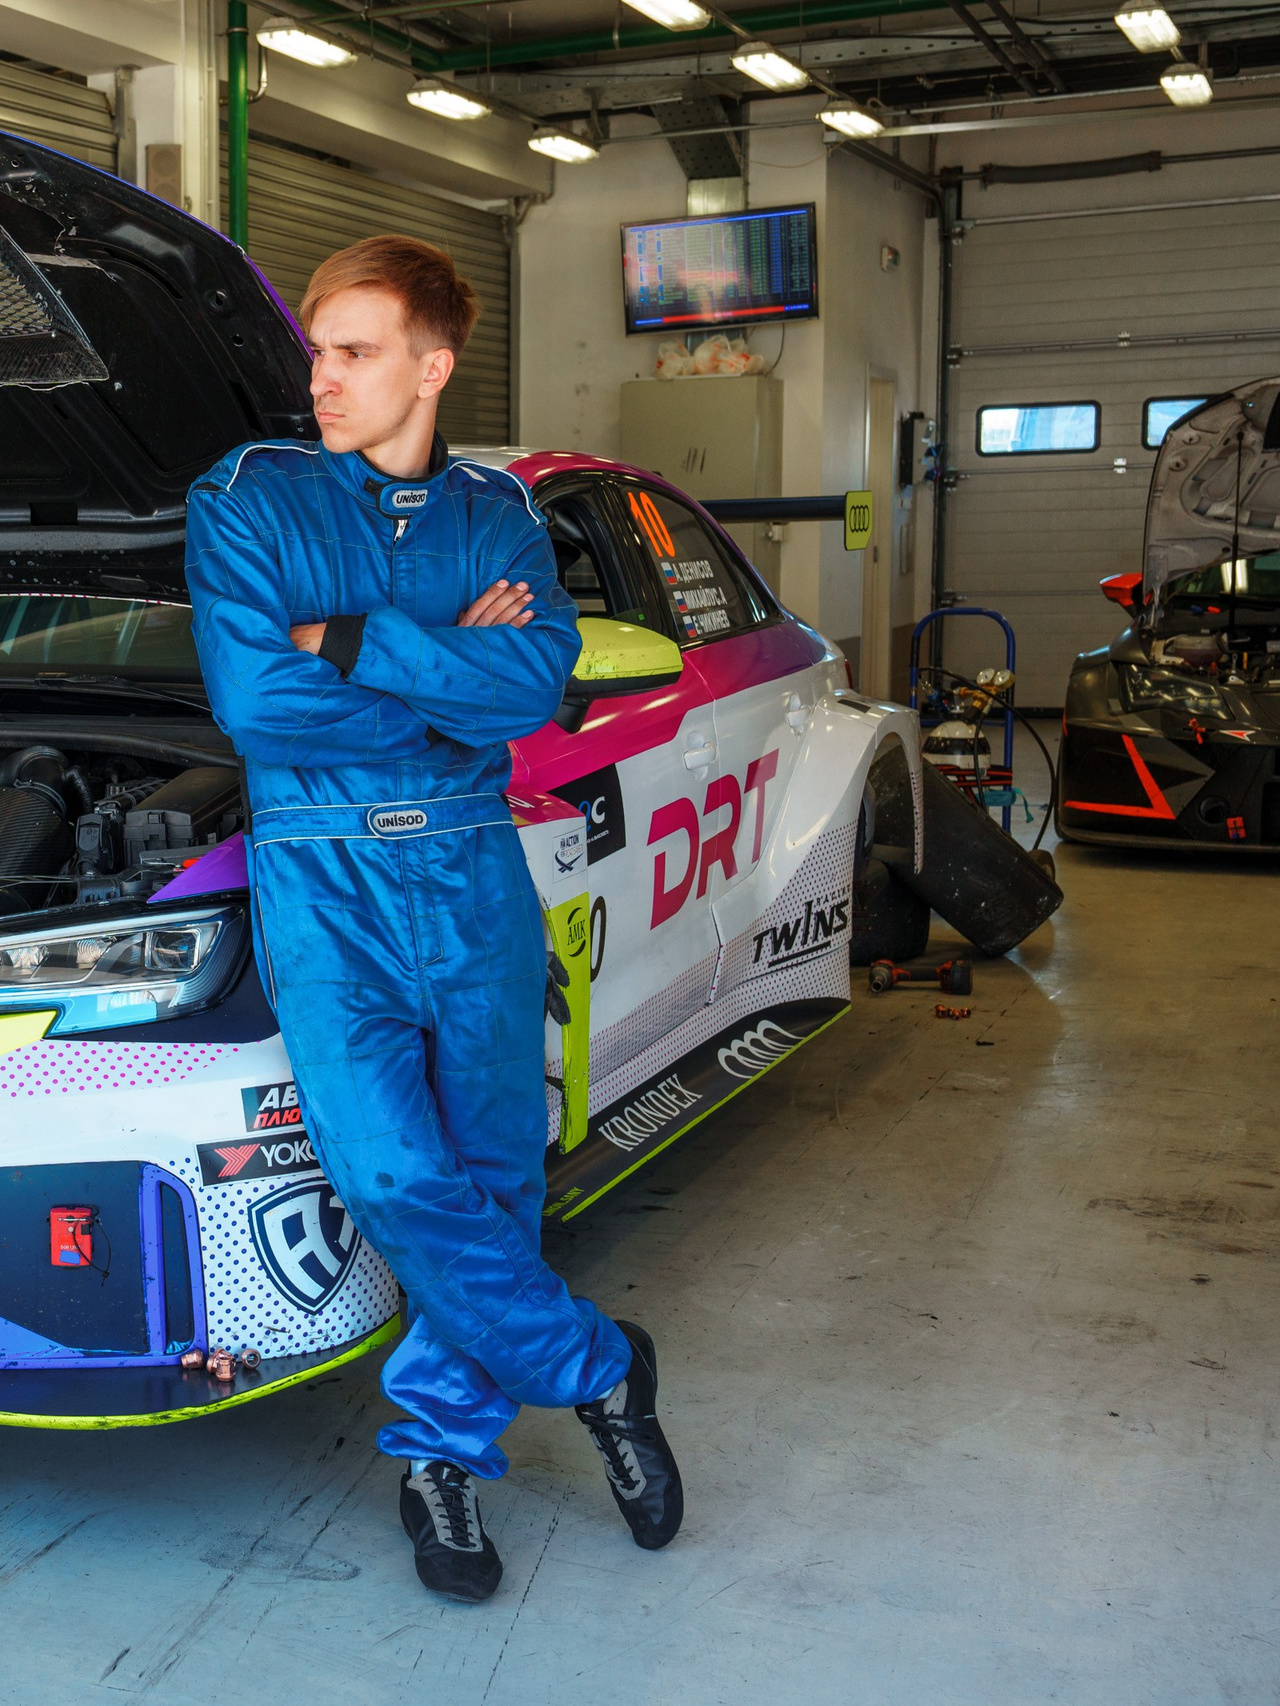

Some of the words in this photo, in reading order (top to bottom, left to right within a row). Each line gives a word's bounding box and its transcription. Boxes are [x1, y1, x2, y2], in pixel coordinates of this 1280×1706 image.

[628, 491, 675, 557] 10
[646, 748, 780, 931] DRT
[753, 899, 850, 964] TWINS
[253, 1108, 301, 1129] ПЛЮ
[598, 1073, 703, 1152] KRONDEX
